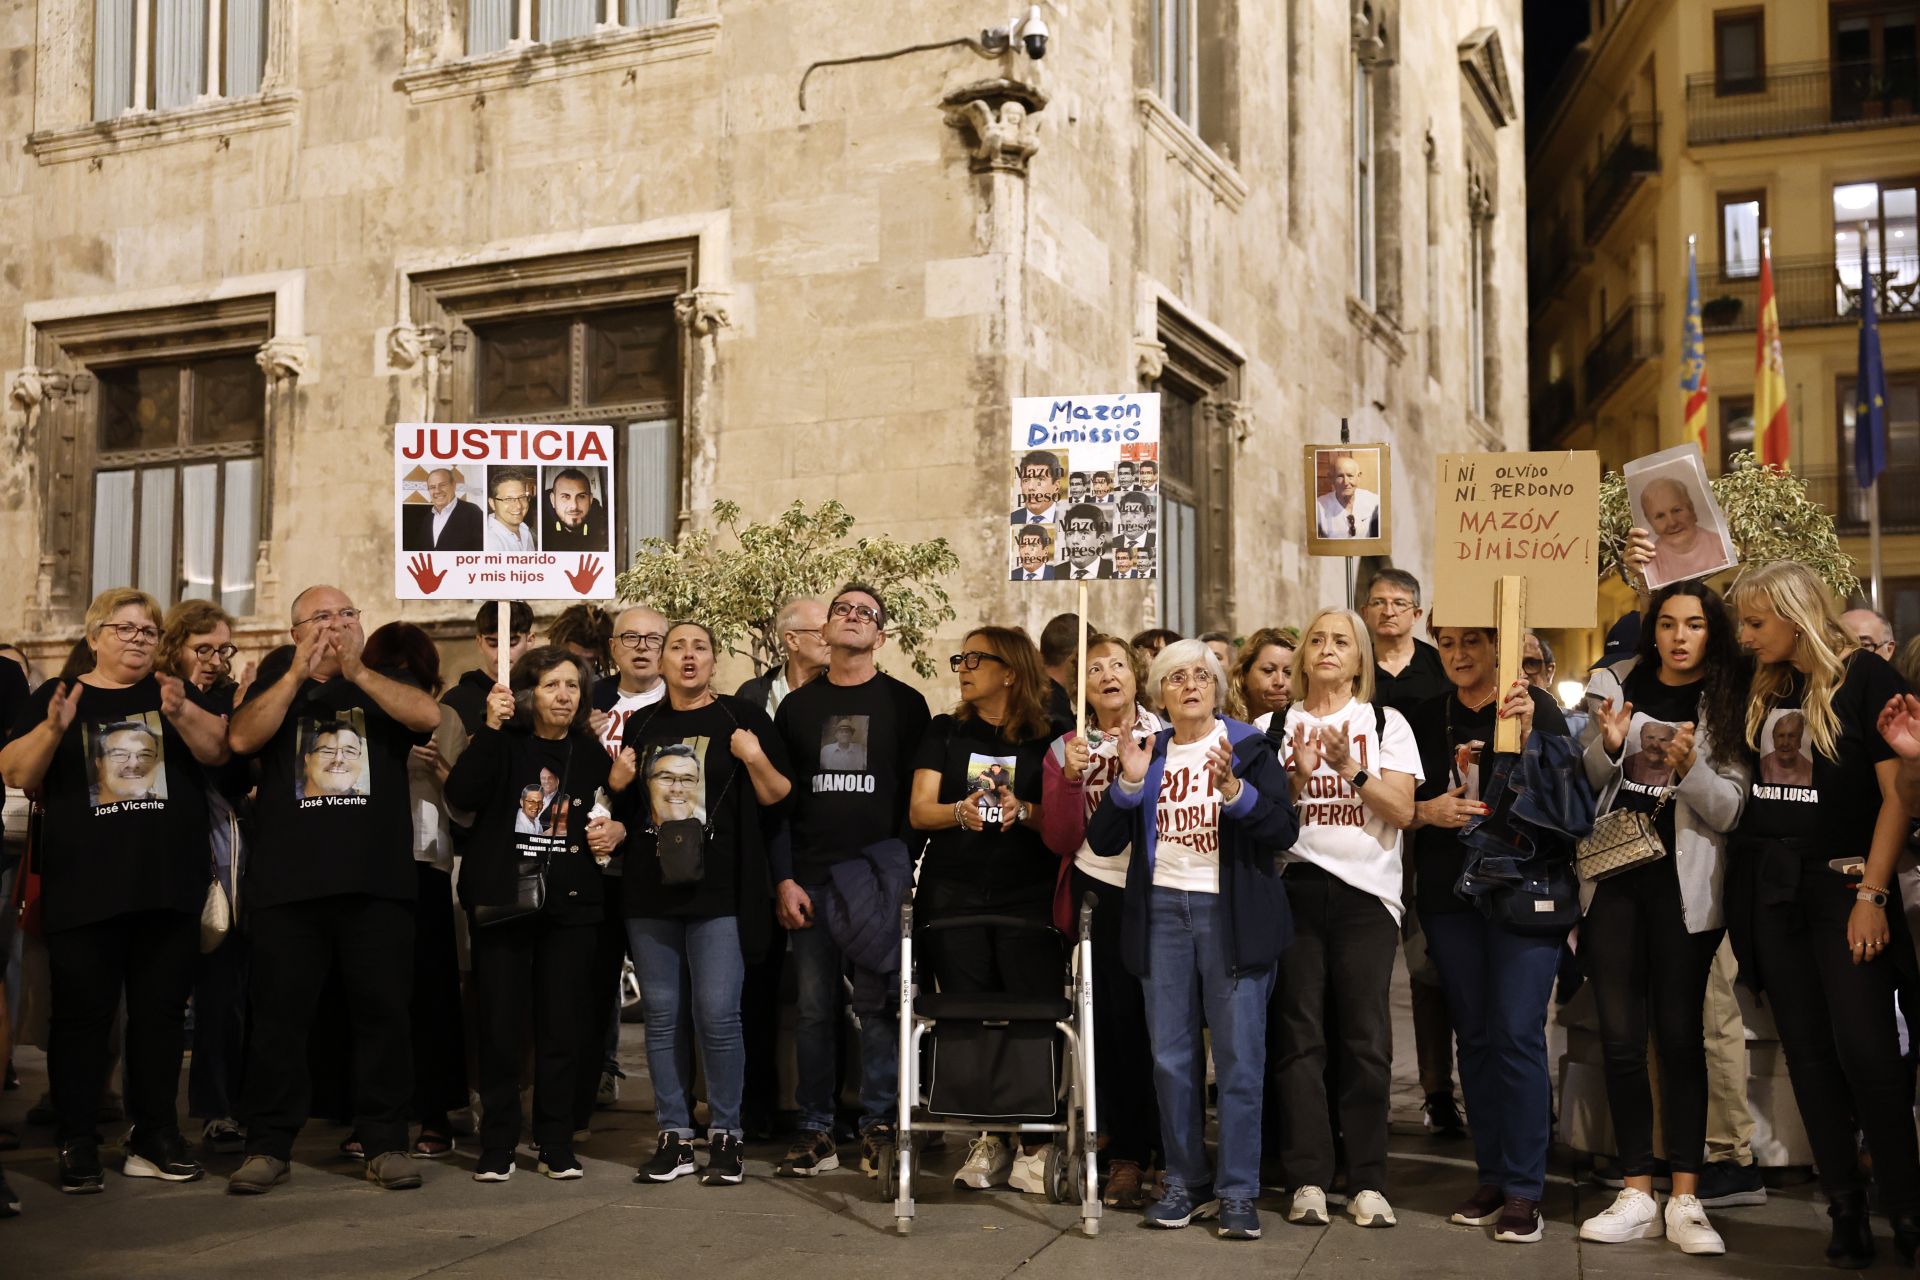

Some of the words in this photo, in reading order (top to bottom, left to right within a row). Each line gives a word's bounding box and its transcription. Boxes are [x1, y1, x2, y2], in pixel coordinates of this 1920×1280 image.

[1049, 395, 1141, 423] Mazón
[1027, 421, 1141, 447] Dimissió
[402, 429, 608, 461] JUSTICIA
[1490, 482, 1574, 500] PERDONO
[1459, 508, 1560, 535] MAZÓN
[456, 554, 480, 566] por
[485, 553, 502, 565] mi
[506, 553, 556, 565] marido
[468, 572, 477, 584] y
[480, 571, 506, 582] mis
[510, 571, 545, 584] hijos
[812, 773, 875, 793] MANOLO
[300, 796, 323, 808] José
[326, 796, 367, 806] Vicente
[1783, 787, 1819, 803] LUISA
[94, 803, 119, 816] José
[121, 800, 165, 811] Vicente
